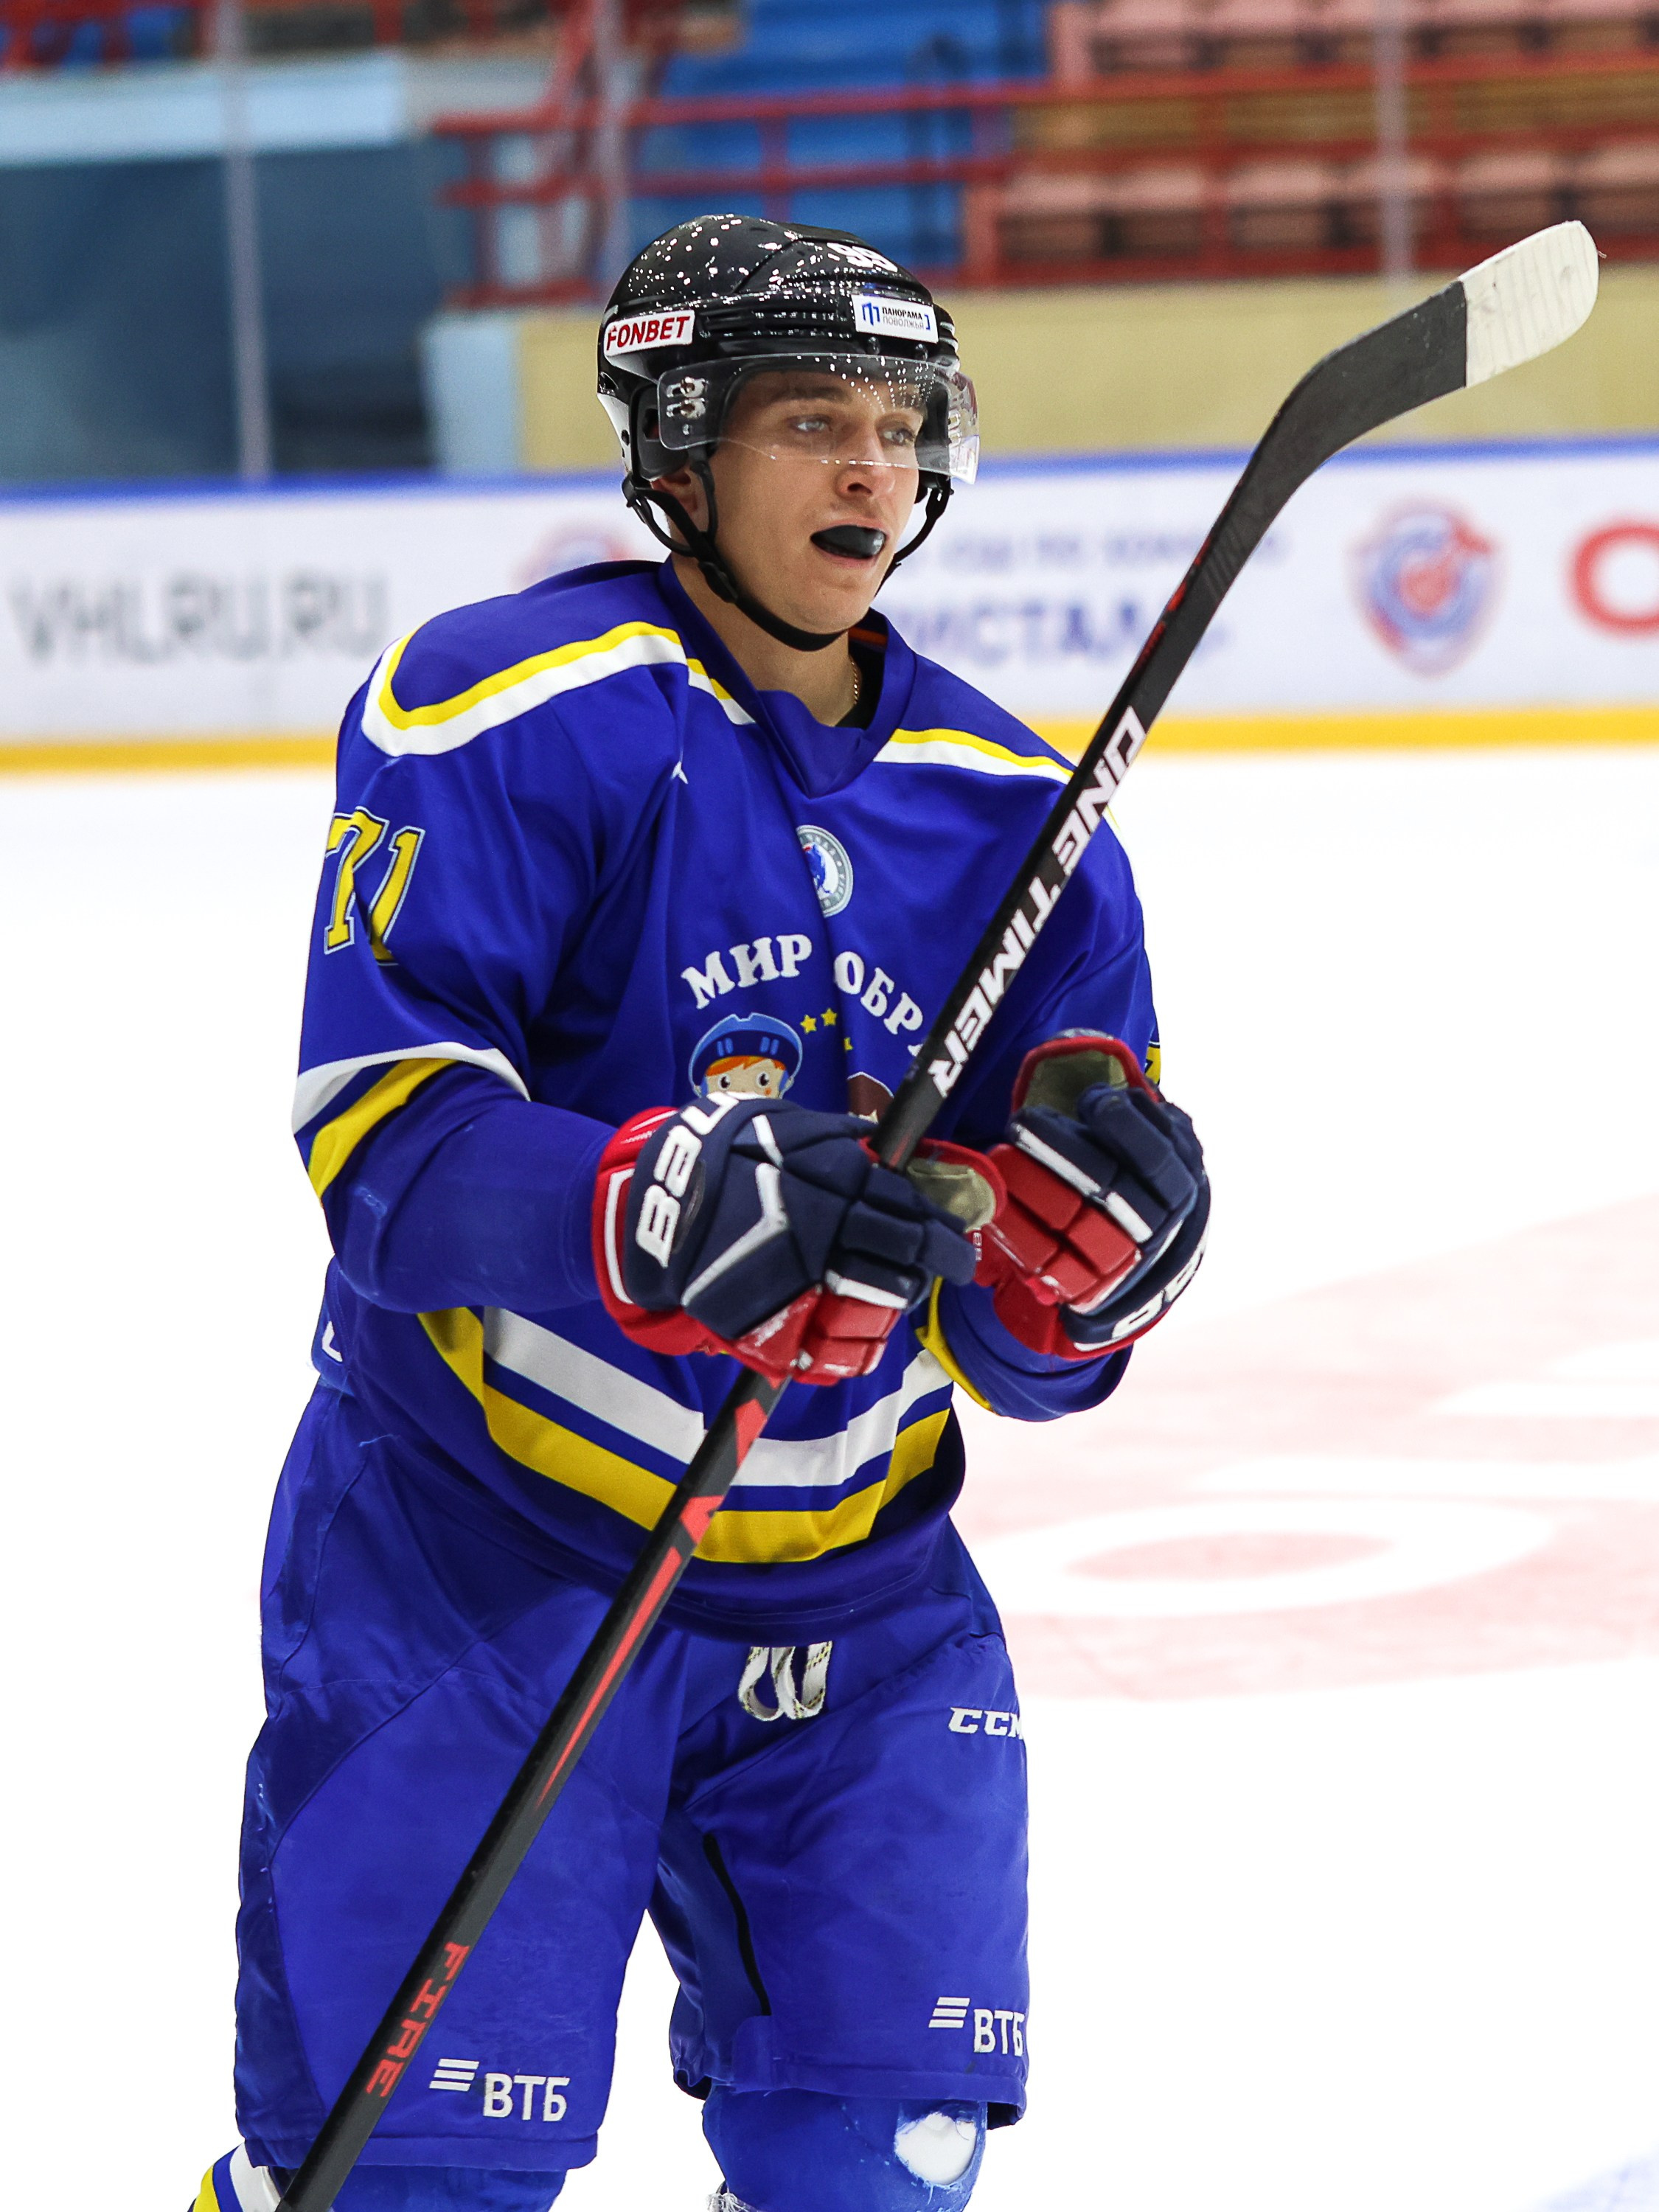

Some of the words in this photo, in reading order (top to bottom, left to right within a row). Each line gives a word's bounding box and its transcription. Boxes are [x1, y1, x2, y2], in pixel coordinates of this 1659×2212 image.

[606, 316, 691, 351] FONBET
[882, 306, 923, 320] ПАНОРАМА
[882, 316, 925, 330] ПОВОЛЖЬЯ
[1051, 705, 1147, 876] ONE
[323, 806, 425, 966] 71
[680, 933, 813, 1010] МИР
[833, 950, 925, 1057] ОБР
[928, 876, 1061, 1099] TIMER
[366, 1941, 471, 2098] FIRE
[973, 2008, 1026, 2057] ВТБ
[482, 2072, 571, 2122] ВТБ
